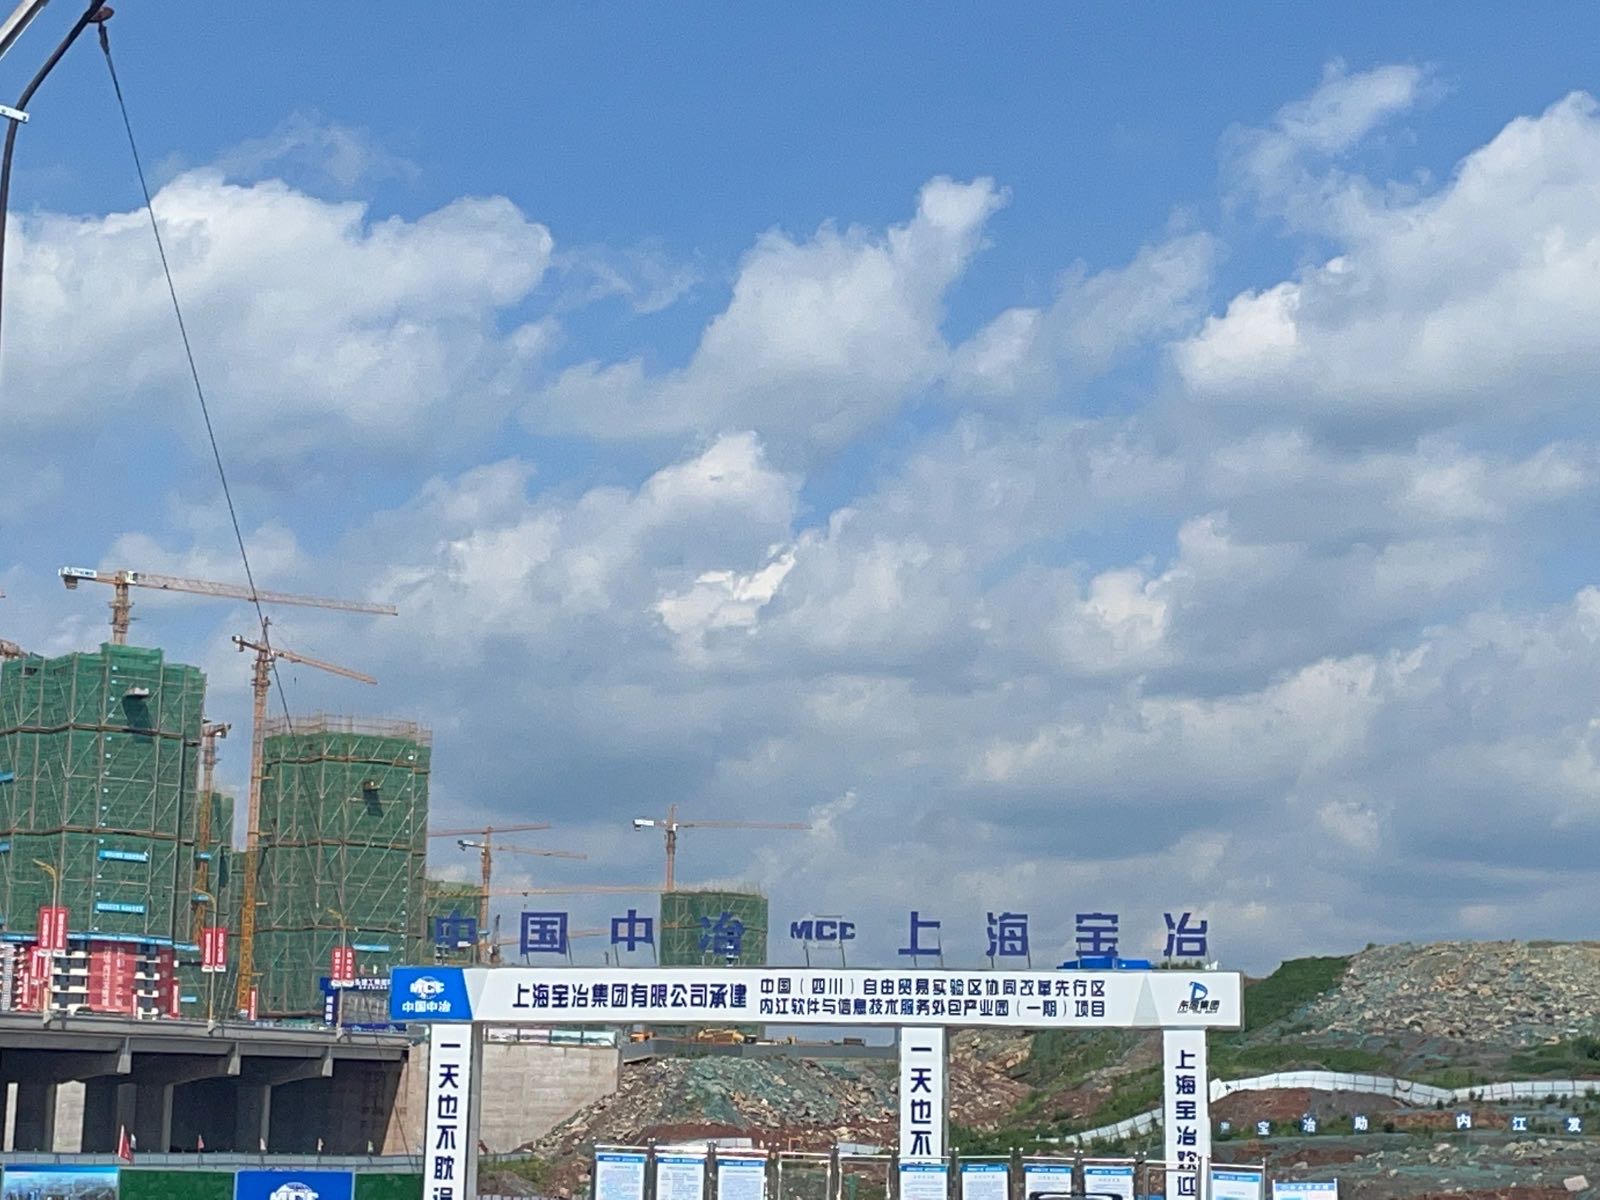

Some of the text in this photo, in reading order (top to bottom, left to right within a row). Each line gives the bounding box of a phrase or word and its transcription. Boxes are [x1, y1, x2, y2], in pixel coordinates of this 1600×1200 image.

[791, 921, 856, 941] MCC
[898, 911, 1208, 957] 上海宝冶
[402, 1000, 451, 1013] 中国中冶
[512, 983, 748, 1009] 上海宝冶集团有限公司承建
[759, 998, 1105, 1017] 内江软件与信息技术服务外包产业园（一期）项目
[910, 1046, 932, 1164] 一天也不
